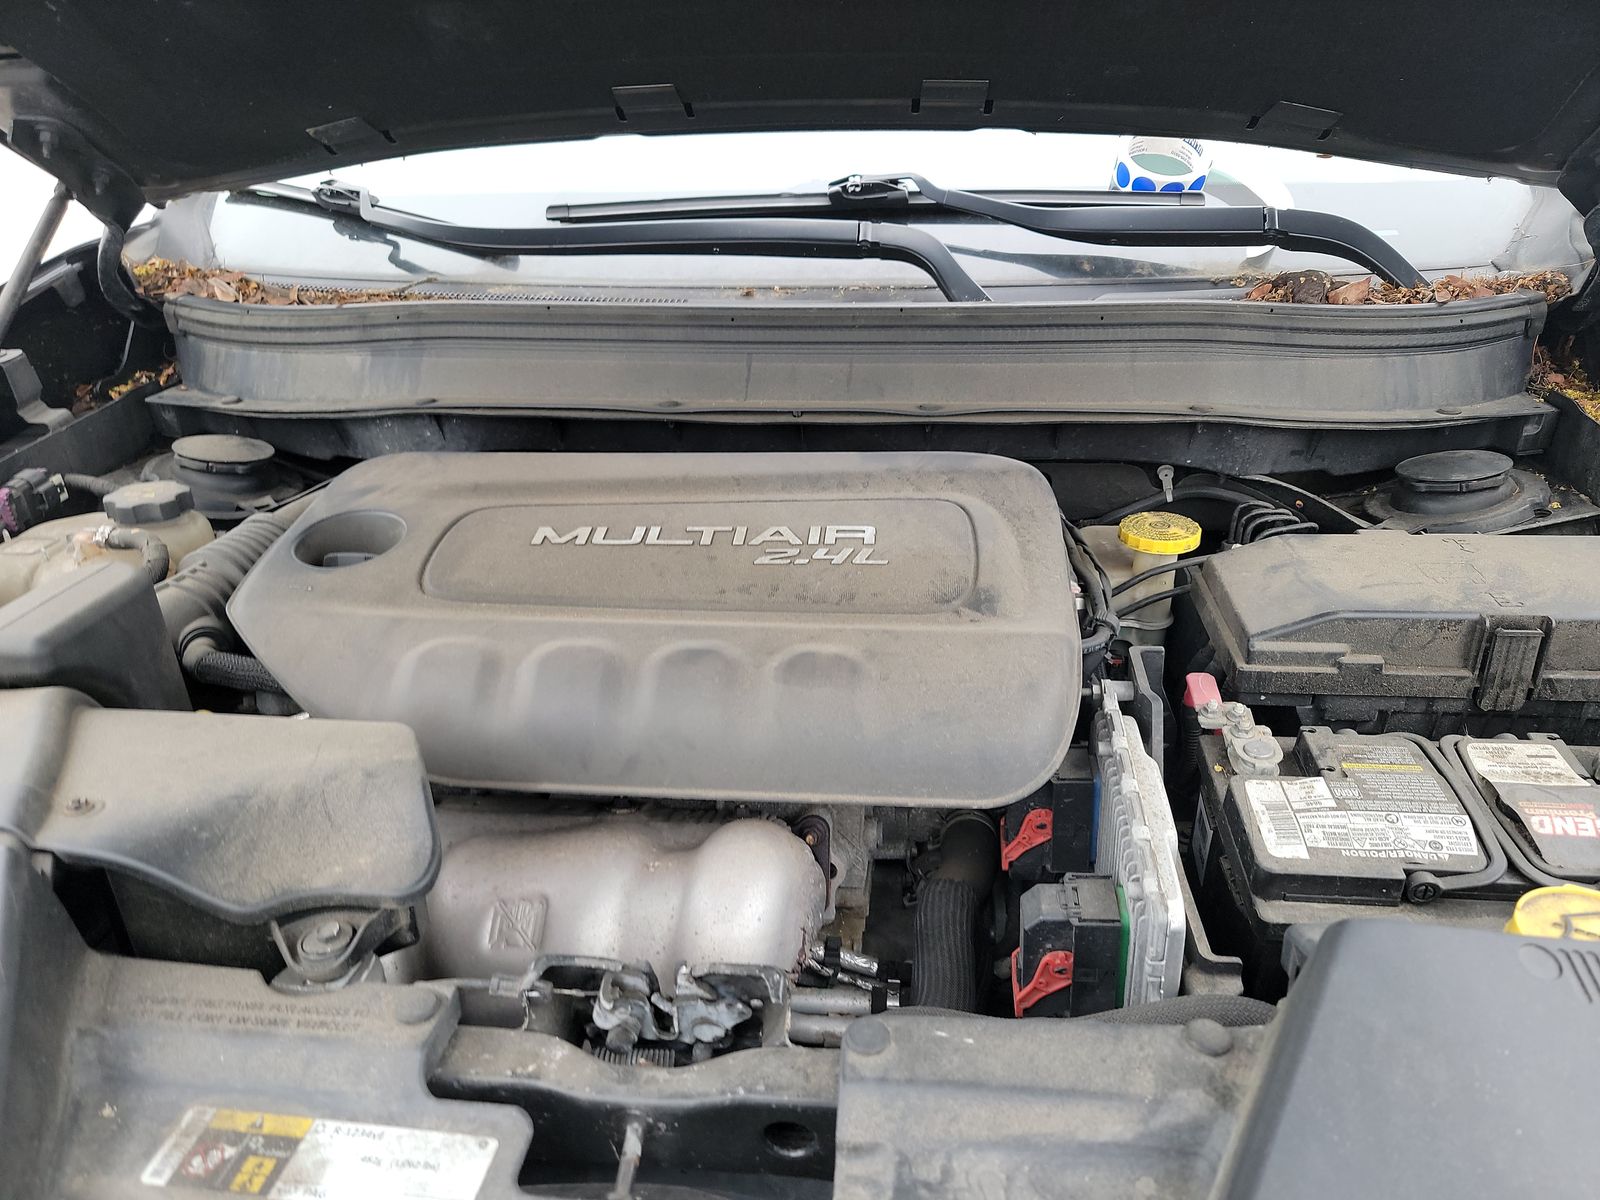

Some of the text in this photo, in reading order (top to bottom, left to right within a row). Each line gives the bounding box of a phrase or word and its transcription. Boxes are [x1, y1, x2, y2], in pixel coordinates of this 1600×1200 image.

[530, 525, 877, 546] MULTIAIR
[753, 547, 890, 566] 2.4L
[1341, 849, 1438, 861] DANGER/POISON
